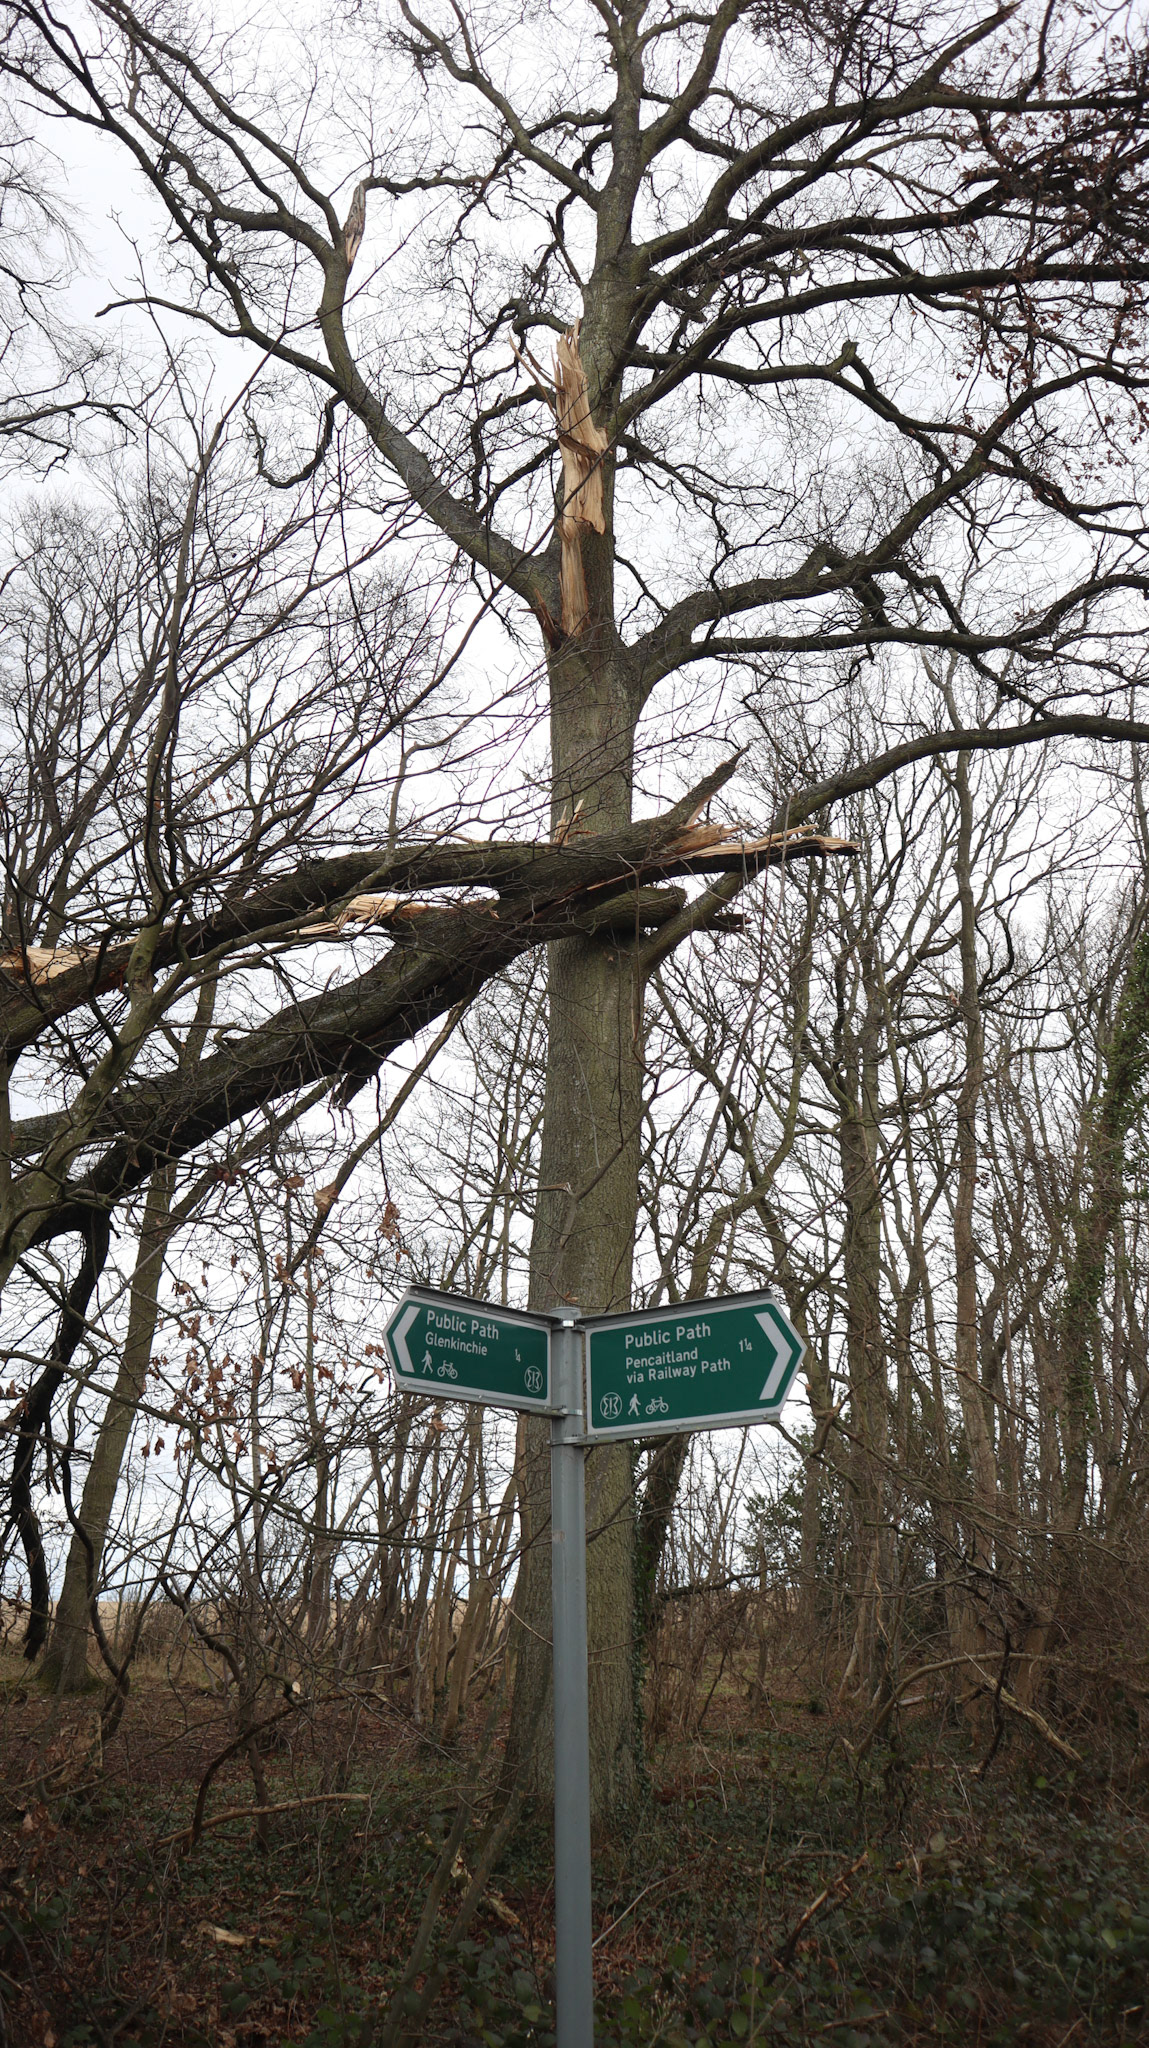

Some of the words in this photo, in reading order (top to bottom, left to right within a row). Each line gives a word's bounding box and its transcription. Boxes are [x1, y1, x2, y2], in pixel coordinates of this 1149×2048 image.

[426, 1310, 467, 1333] Public
[471, 1320, 499, 1340] Path
[625, 1329, 671, 1349] Public
[676, 1322, 711, 1341] Path
[425, 1331, 488, 1356] Glenkinchie
[626, 1347, 698, 1369] Pencaitland
[626, 1369, 644, 1384] via
[648, 1364, 697, 1381] Railway
[701, 1358, 731, 1374] Path
